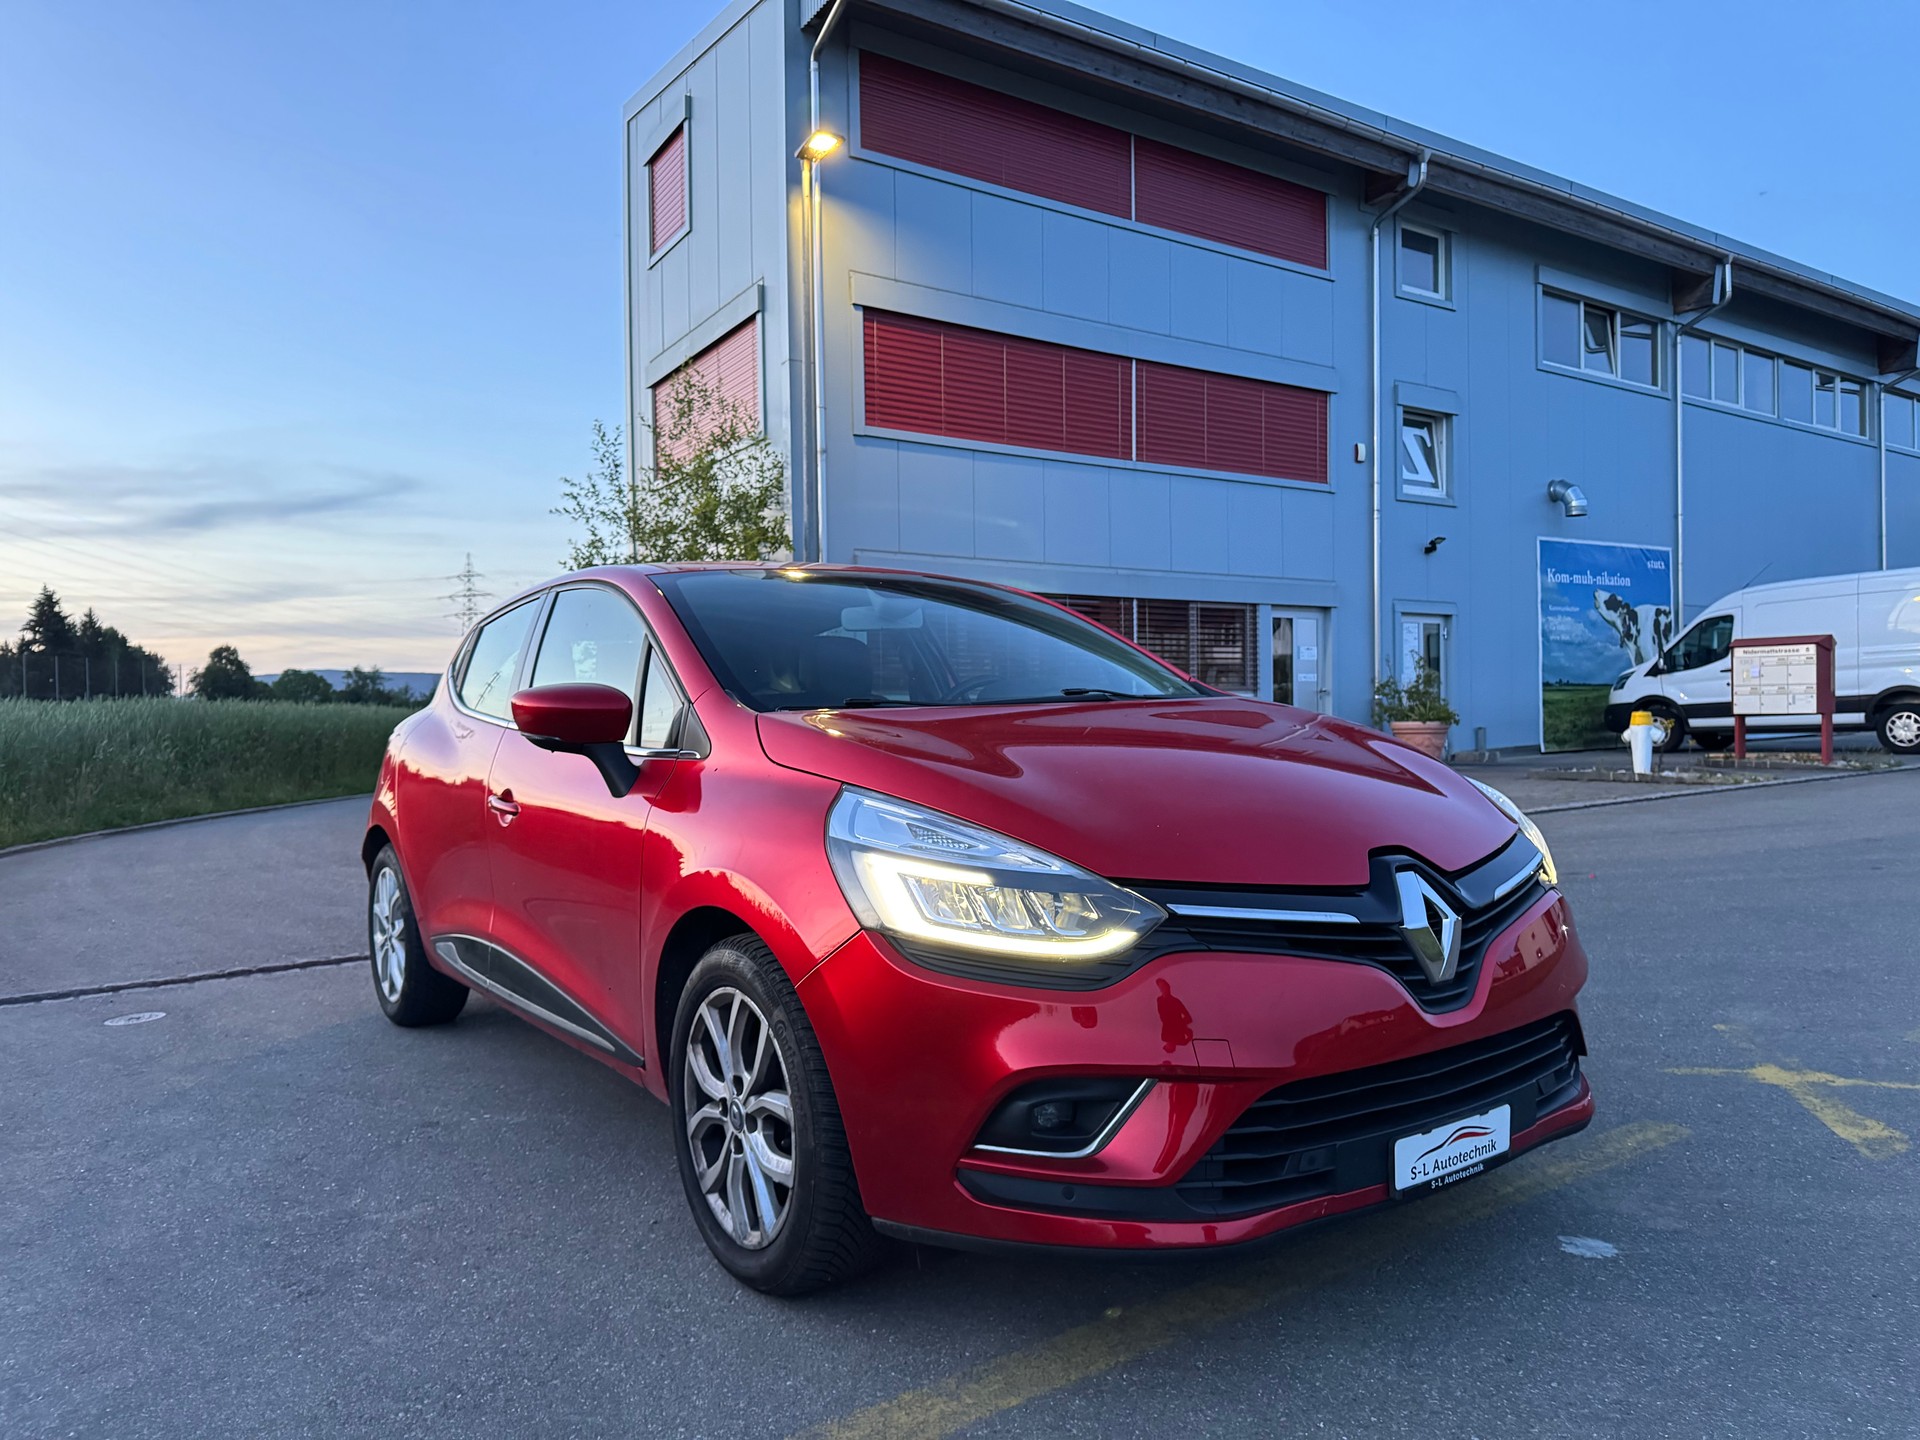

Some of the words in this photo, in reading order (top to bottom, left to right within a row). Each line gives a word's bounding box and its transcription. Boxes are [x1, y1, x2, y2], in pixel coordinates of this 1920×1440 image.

[1547, 568, 1631, 587] Kom-muh-nikation
[1410, 1163, 1429, 1180] S-L
[1432, 1139, 1497, 1173] Autotechnik
[1431, 1178, 1443, 1189] S-L
[1444, 1163, 1484, 1185] Autotechnik
